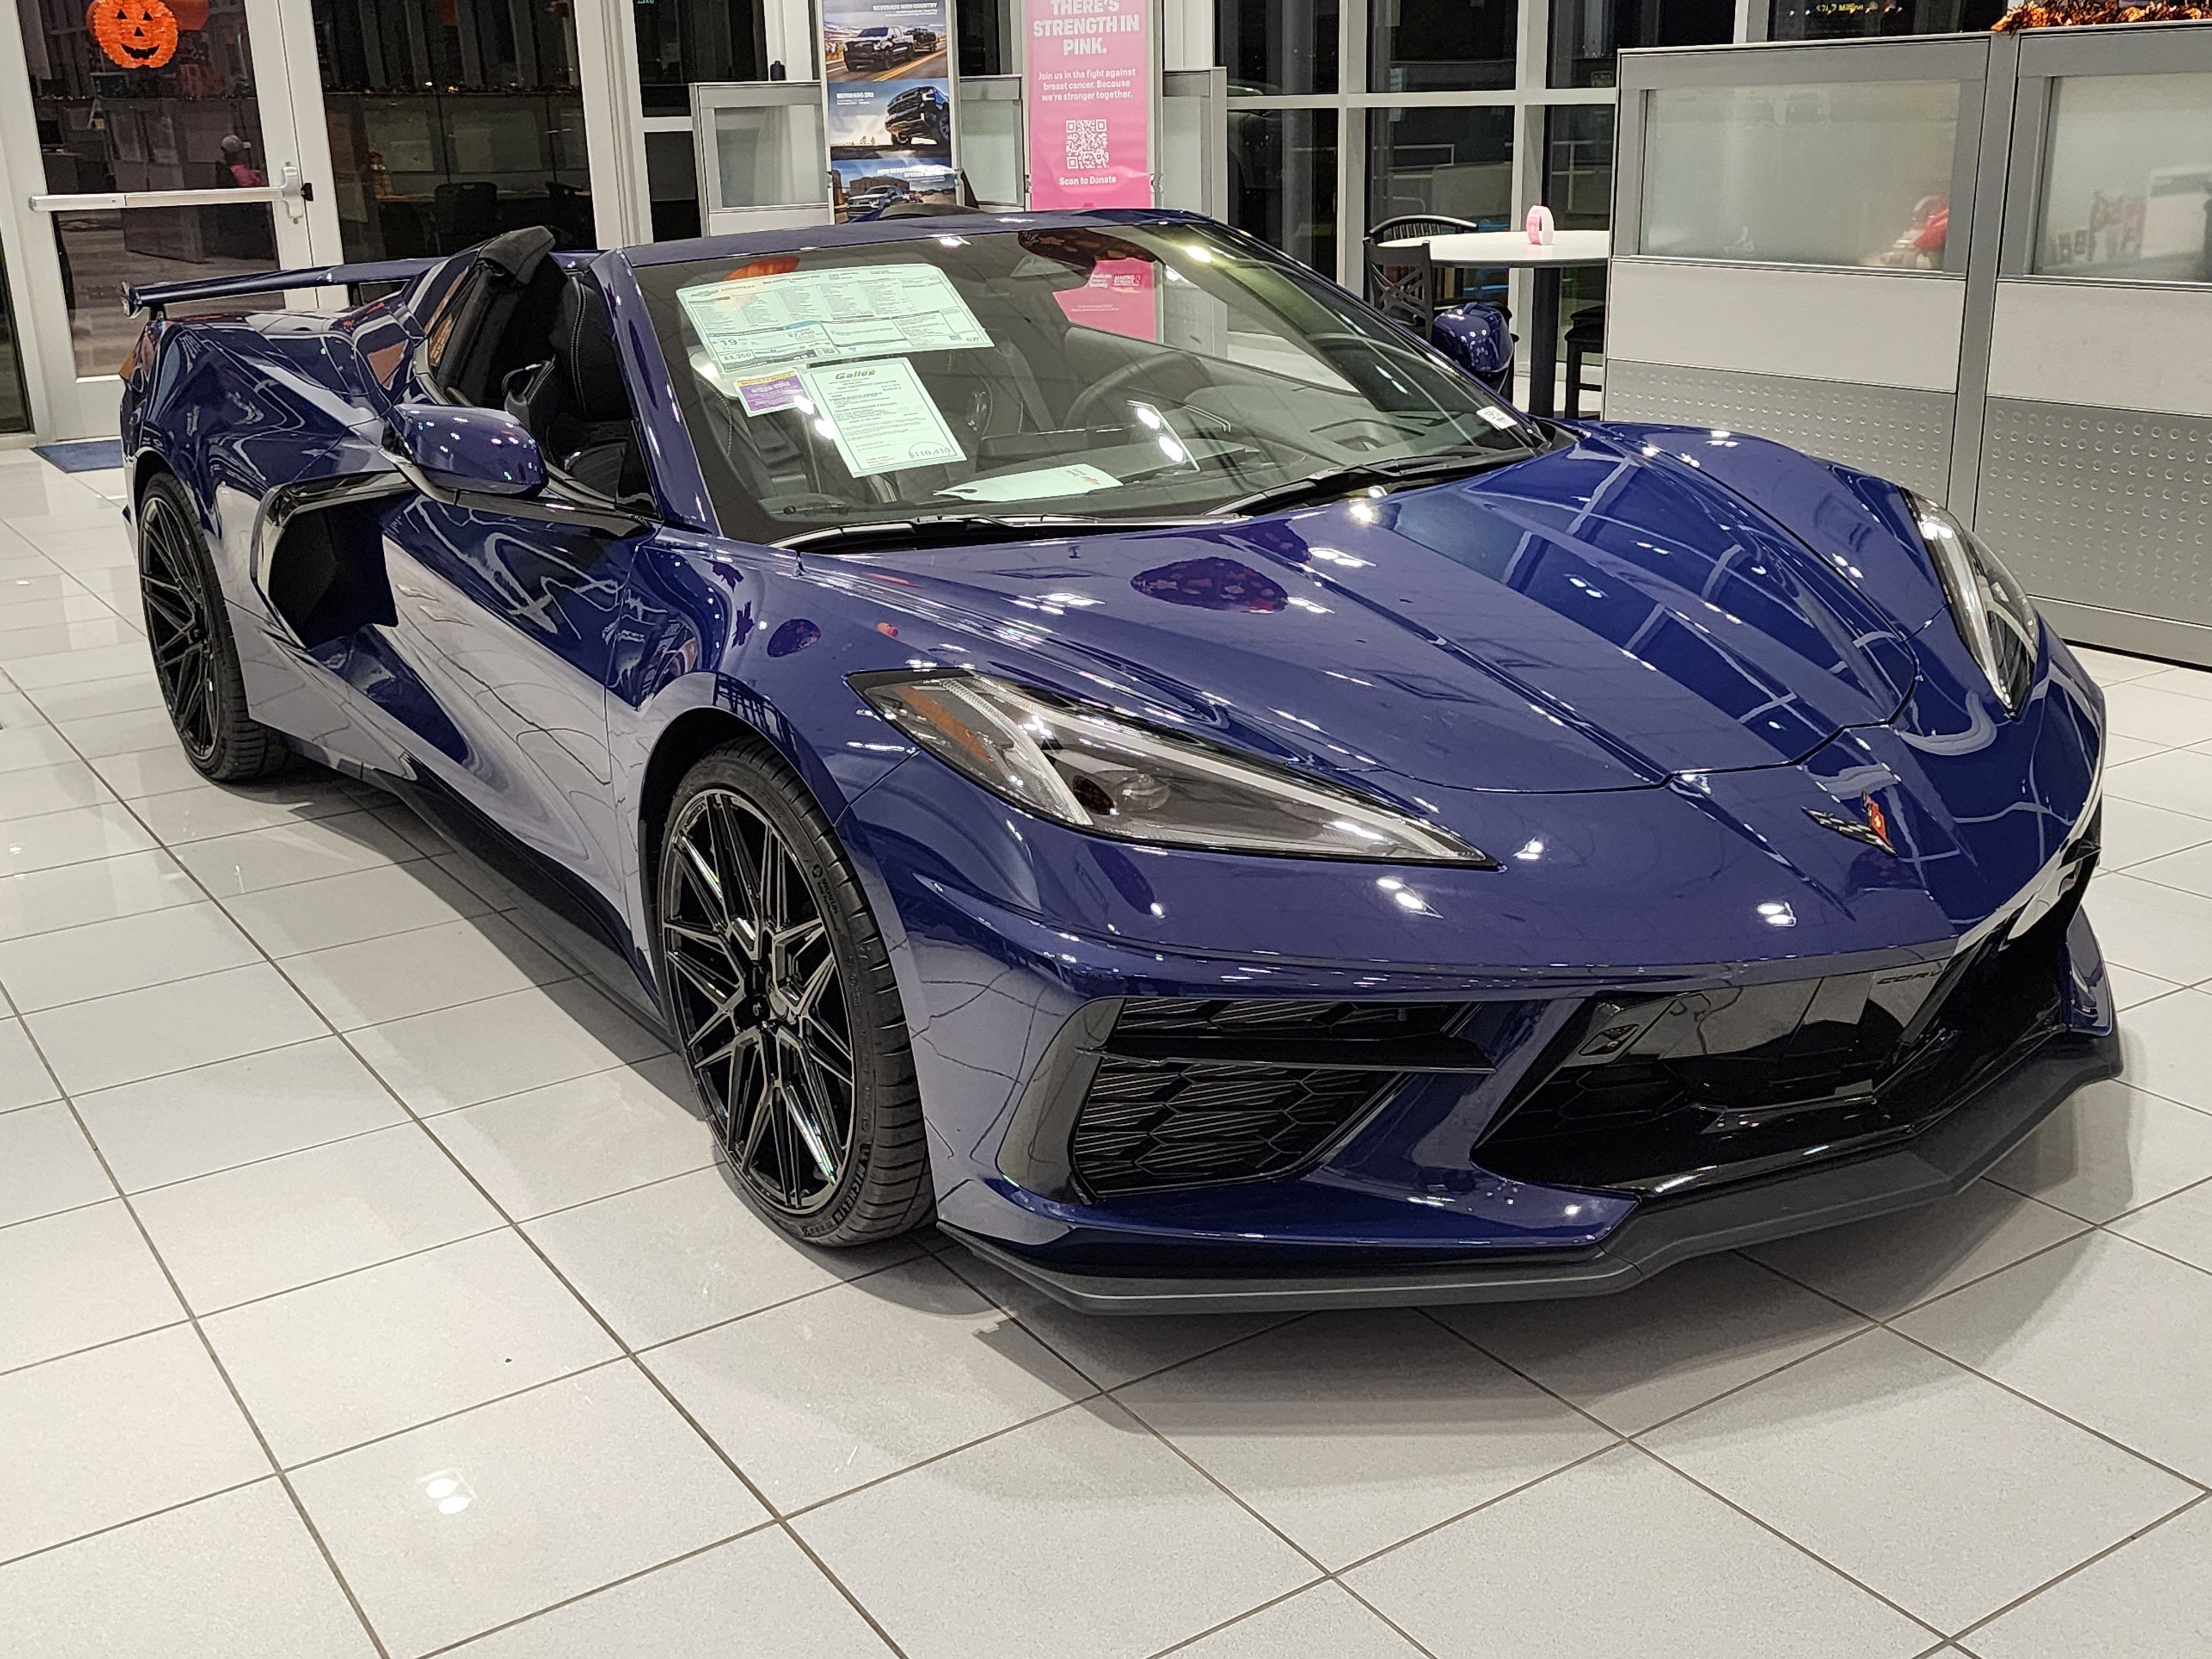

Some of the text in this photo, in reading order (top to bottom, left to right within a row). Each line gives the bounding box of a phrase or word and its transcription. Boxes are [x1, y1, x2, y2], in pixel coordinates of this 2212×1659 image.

[1051, 0, 1119, 15] THERE'S
[1034, 14, 1139, 36] STRENGTH IN
[1063, 37, 1107, 55] PINK.
[1039, 71, 1052, 80] Join
[1065, 70, 1071, 79] in
[1087, 69, 1104, 79] fight
[1105, 68, 1136, 79] against
[1097, 80, 1130, 88] Because
[1063, 92, 1095, 101] stronger
[1096, 90, 1133, 100] together.
[1059, 177, 1079, 185] Scan
[1089, 175, 1117, 184] Donate
[822, 878, 838, 914] MICHELIN
[1876, 969, 1943, 984] CORV
[834, 1162, 866, 1223] MICHELIN
